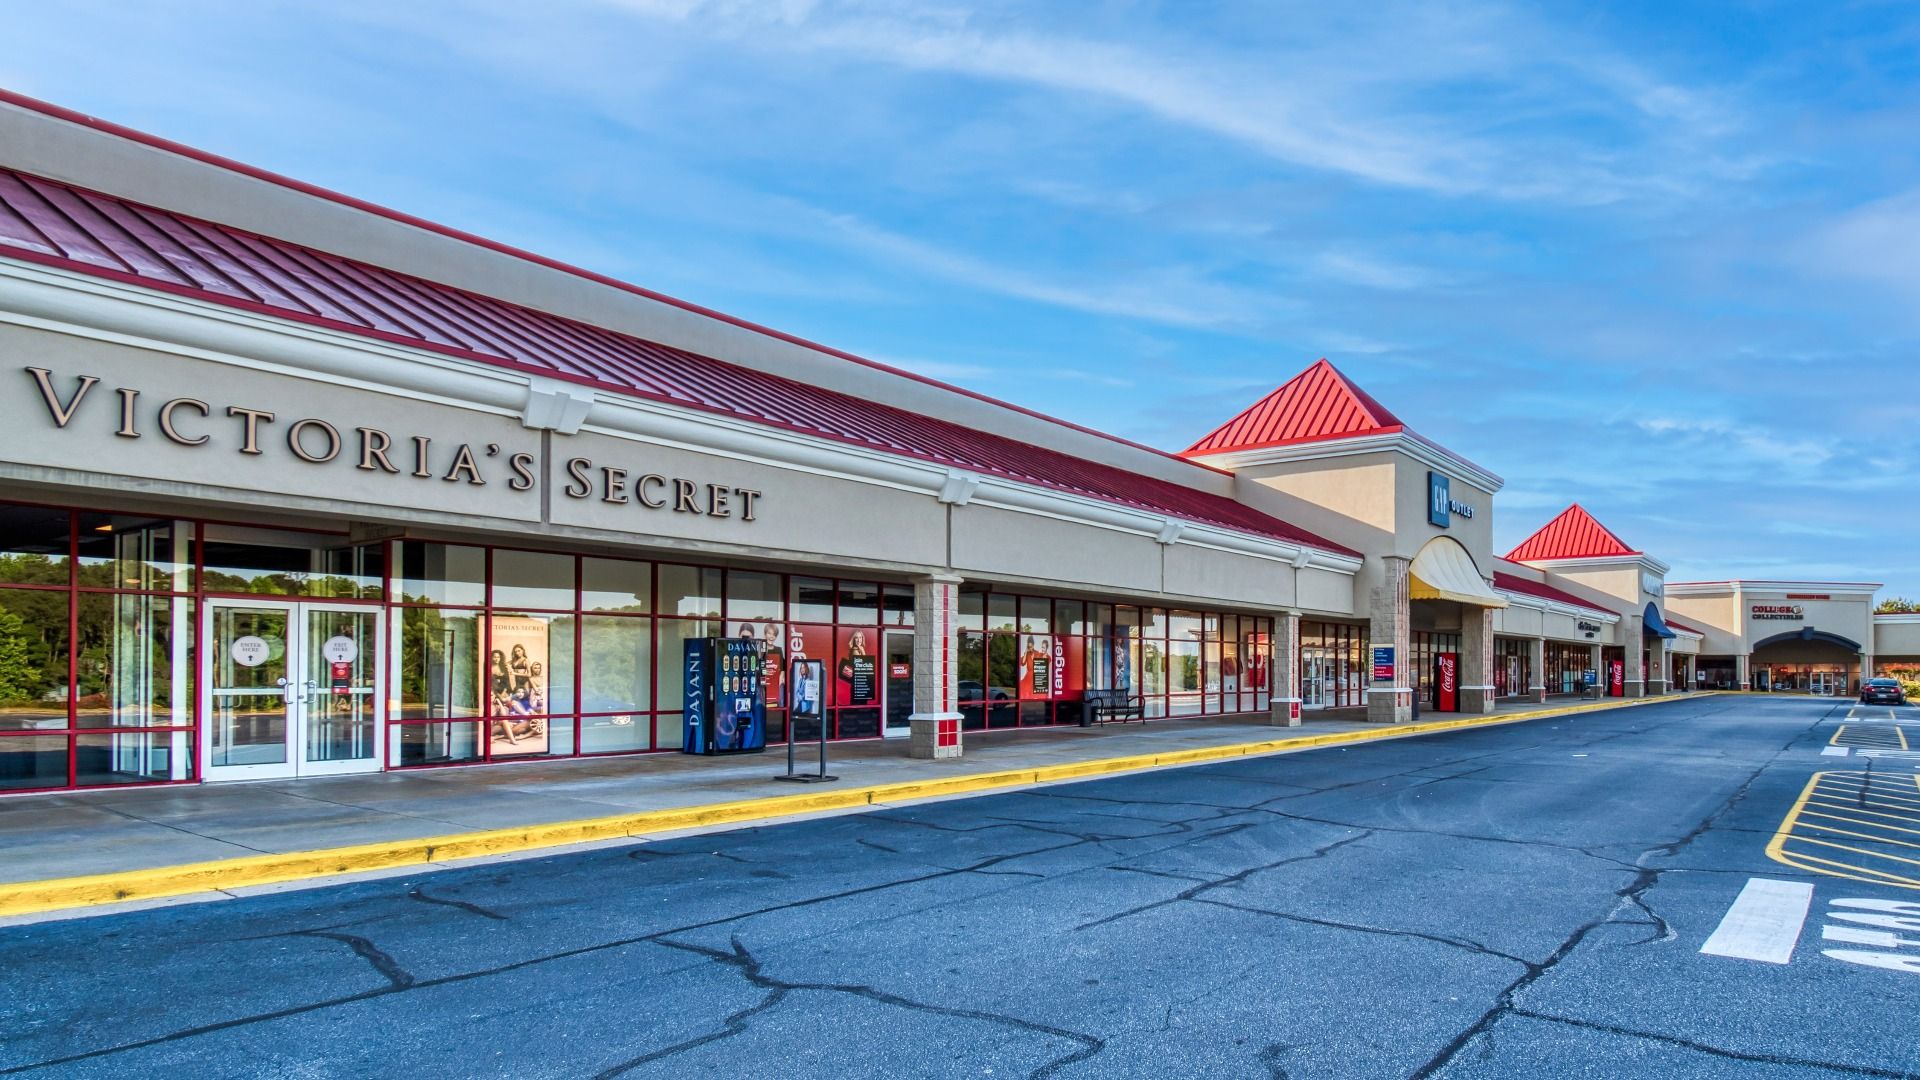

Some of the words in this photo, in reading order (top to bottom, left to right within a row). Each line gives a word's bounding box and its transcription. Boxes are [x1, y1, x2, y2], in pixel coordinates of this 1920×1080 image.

[25, 366, 536, 491] VICTORIA'S
[565, 457, 762, 521] SECRET
[1434, 485, 1447, 515] GAP
[1450, 500, 1474, 519] OUTLET
[728, 643, 760, 652] DASANI
[688, 652, 702, 726] DASANI
